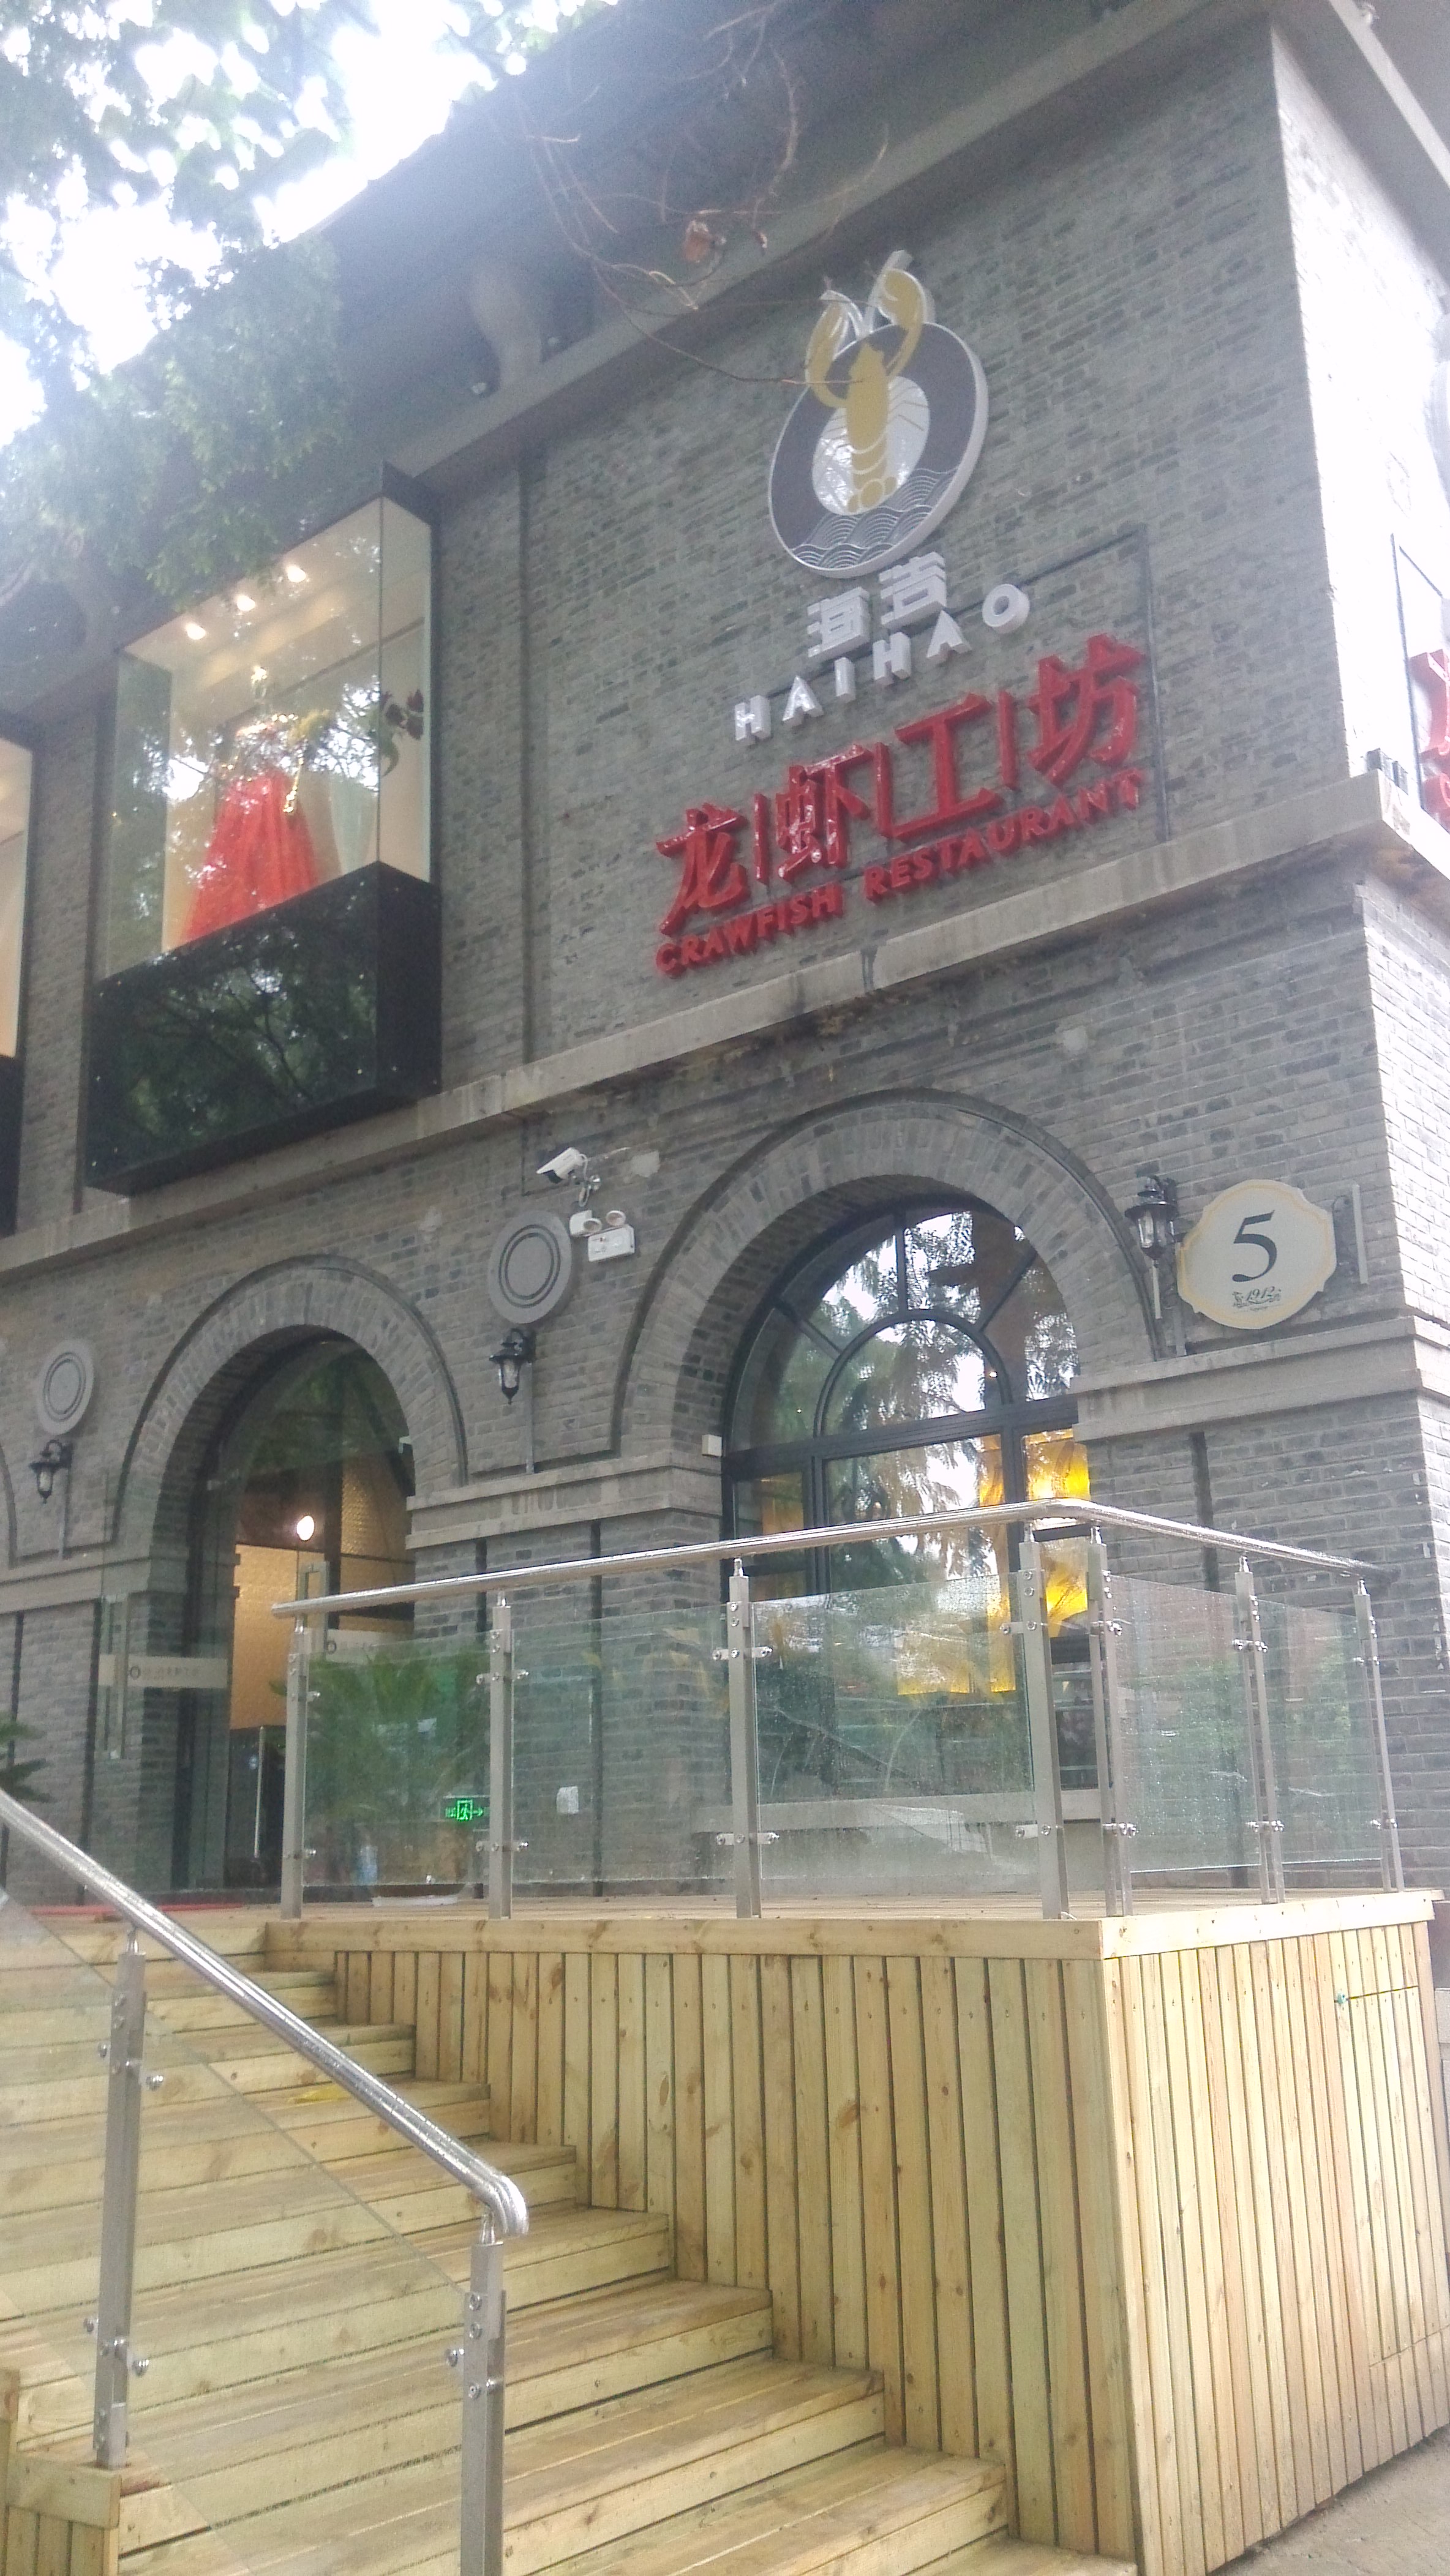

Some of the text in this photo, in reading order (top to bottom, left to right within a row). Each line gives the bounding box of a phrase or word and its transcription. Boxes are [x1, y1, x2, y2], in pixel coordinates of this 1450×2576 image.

[655, 768, 1146, 977] CRAWFISH RESTAURANT
[656, 632, 1146, 936] 龙虾工坊
[1232, 1209, 1278, 1282] 5
